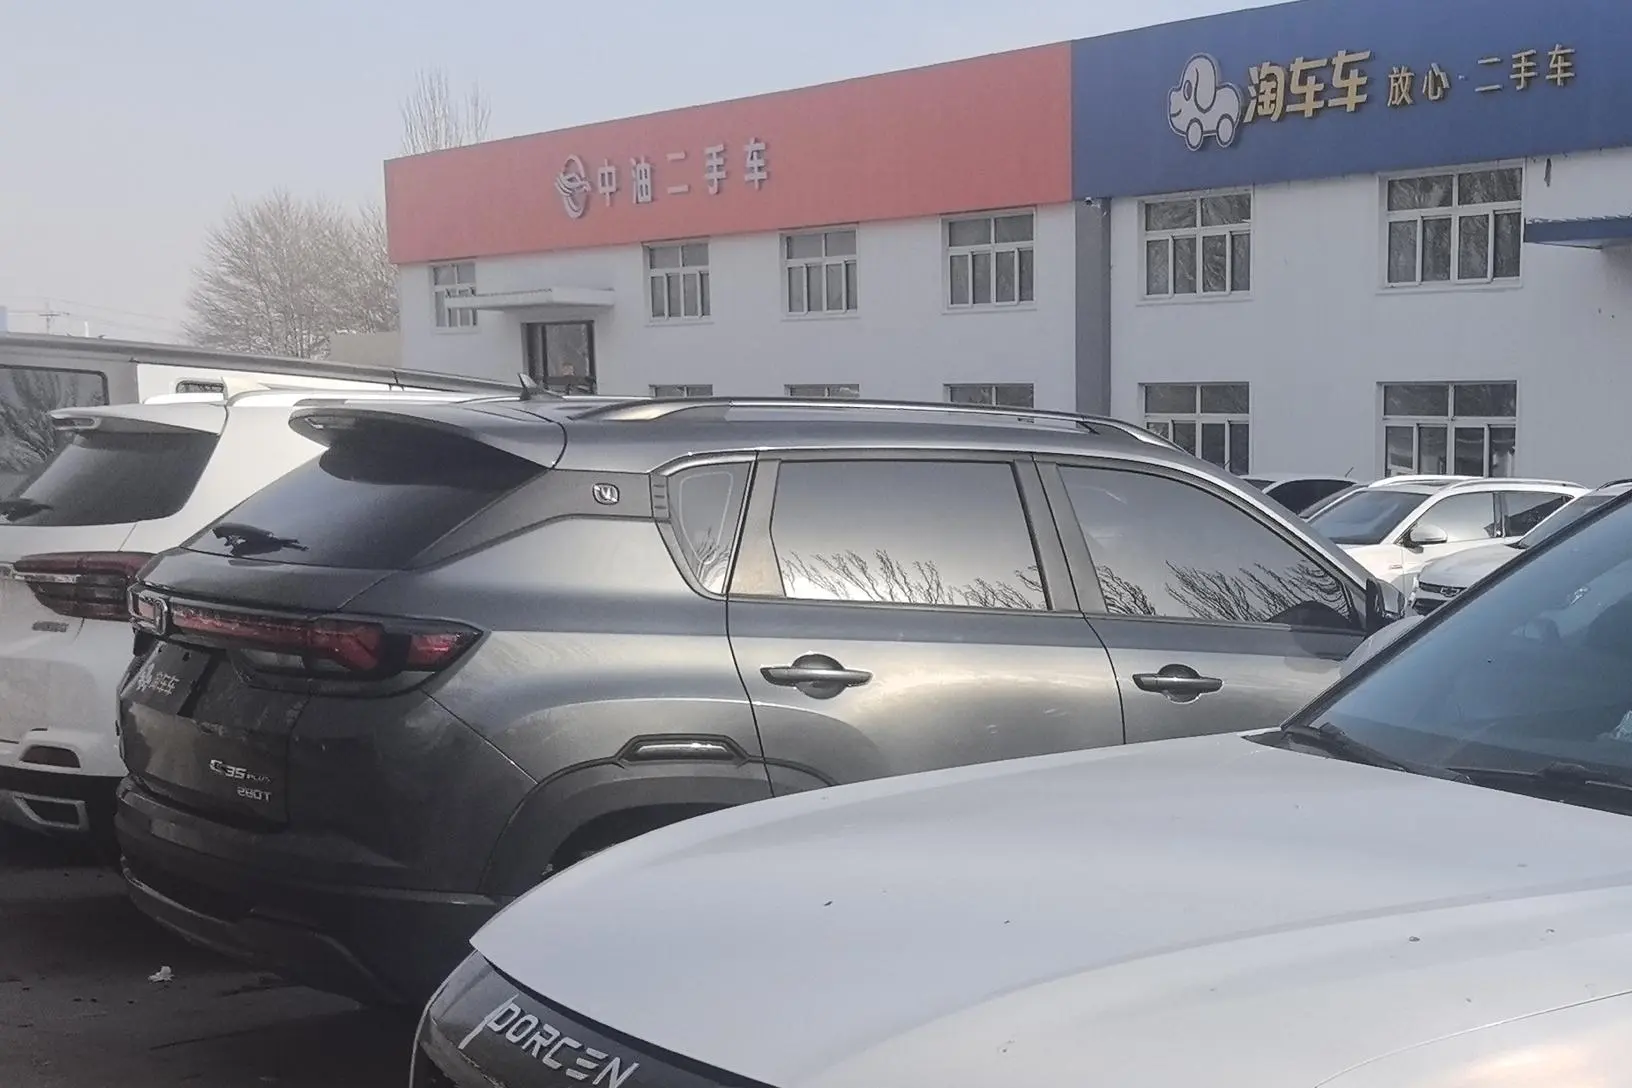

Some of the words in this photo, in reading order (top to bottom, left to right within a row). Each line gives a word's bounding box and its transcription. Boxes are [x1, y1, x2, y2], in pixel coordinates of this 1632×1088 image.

[1243, 49, 1371, 124] 淘车车
[599, 137, 768, 207] 中油二手车
